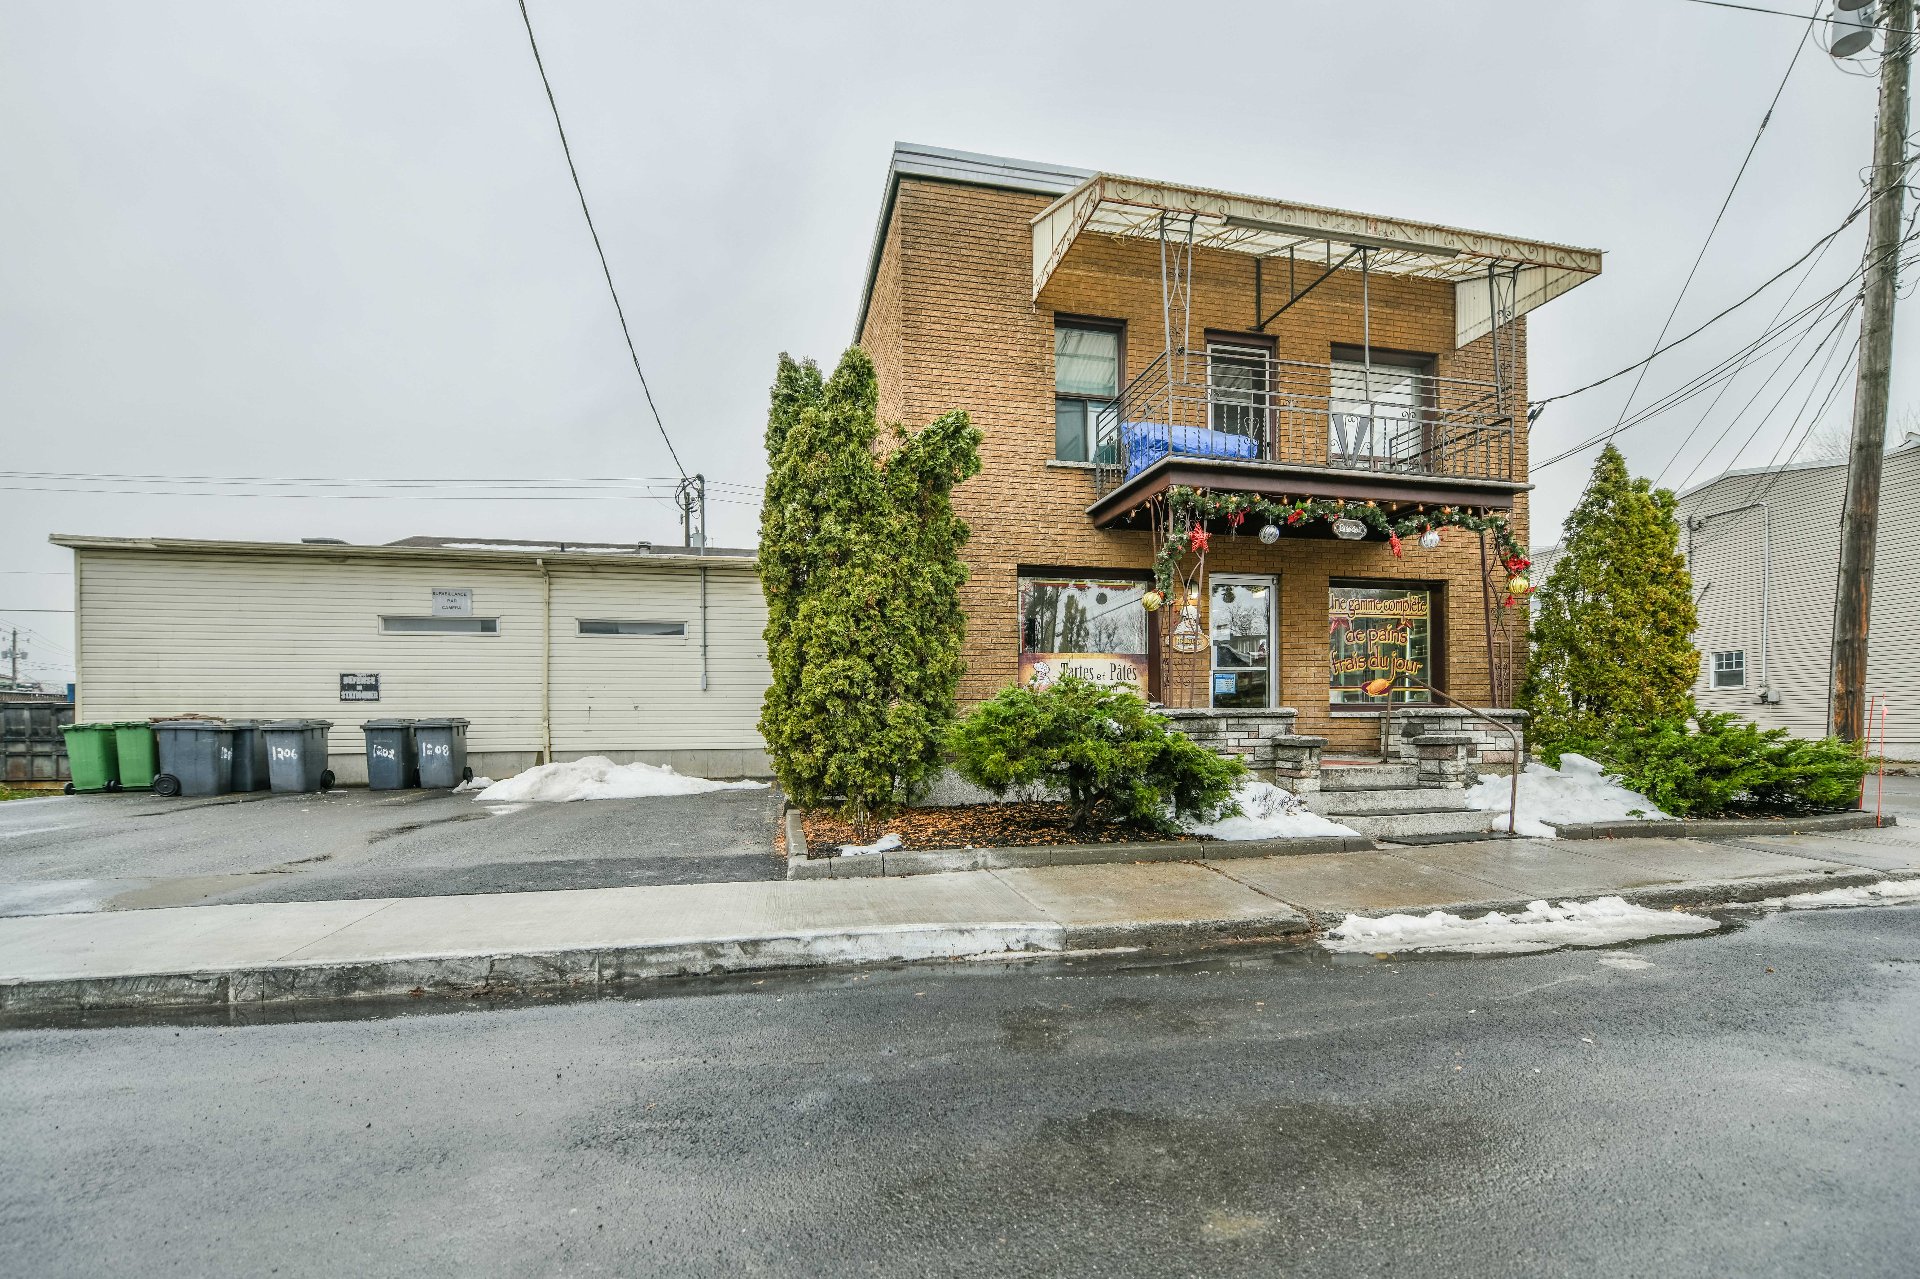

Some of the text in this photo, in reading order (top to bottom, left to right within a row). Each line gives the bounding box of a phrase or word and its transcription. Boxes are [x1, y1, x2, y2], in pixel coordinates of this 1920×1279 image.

[1347, 598, 1383, 618] gamme
[1344, 618, 1408, 653] de pains
[1060, 662, 1137, 681] Tartes et Pâtés
[1330, 645, 1423, 682] frais du jour
[272, 745, 298, 761] 1206
[422, 742, 449, 757] 1208
